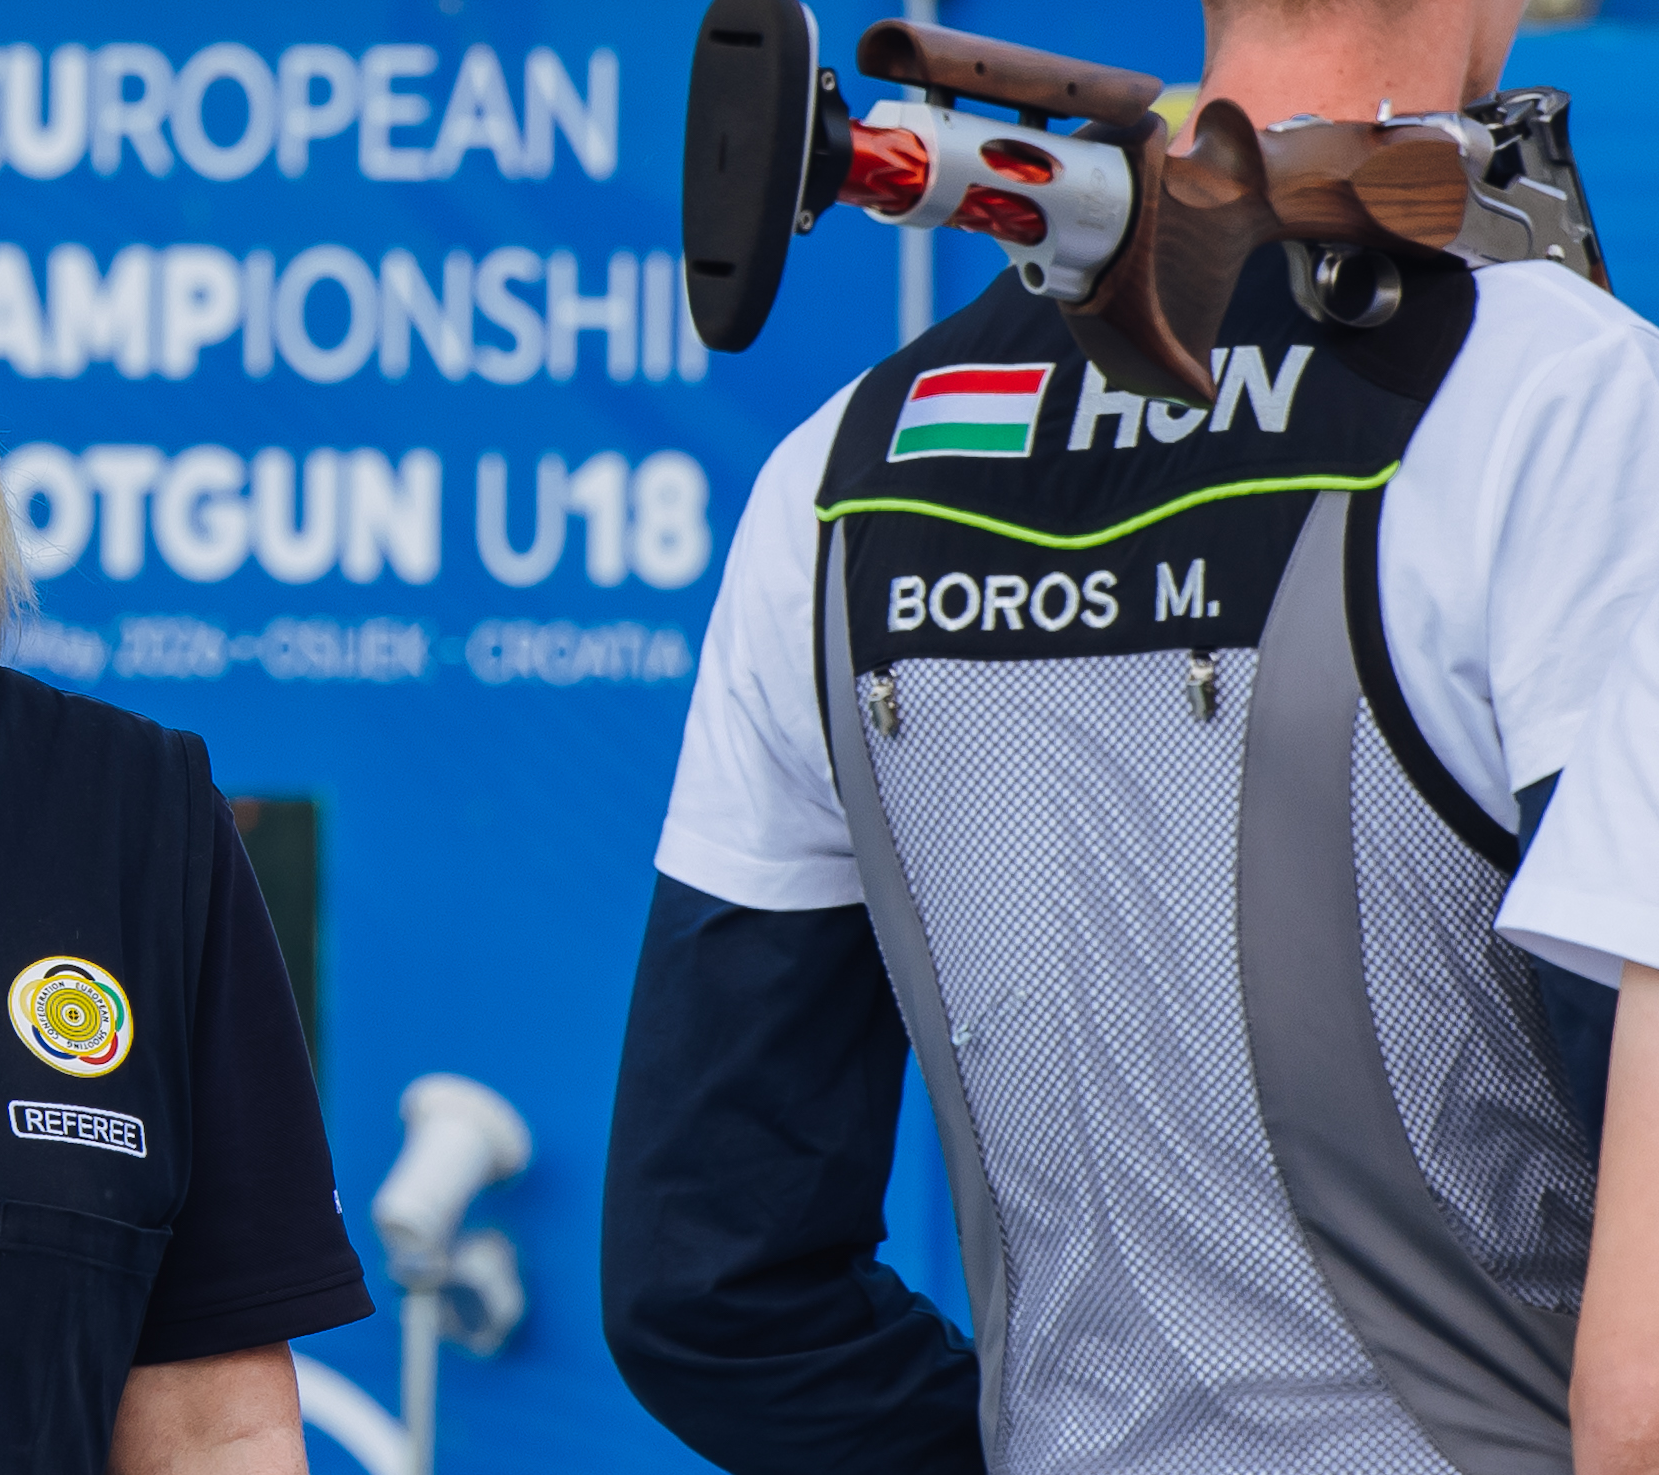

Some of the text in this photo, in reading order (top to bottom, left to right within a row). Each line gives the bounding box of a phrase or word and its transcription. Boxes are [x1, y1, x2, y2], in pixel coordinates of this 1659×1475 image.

[475, 448, 712, 590] U18
[888, 558, 1220, 633] BOROS M.
[36, 981, 75, 1040] CONFEDERATION
[75, 982, 110, 1023] EUROPEAN
[66, 1029, 109, 1050] SHOOTING
[24, 1108, 137, 1149] REFEREE
